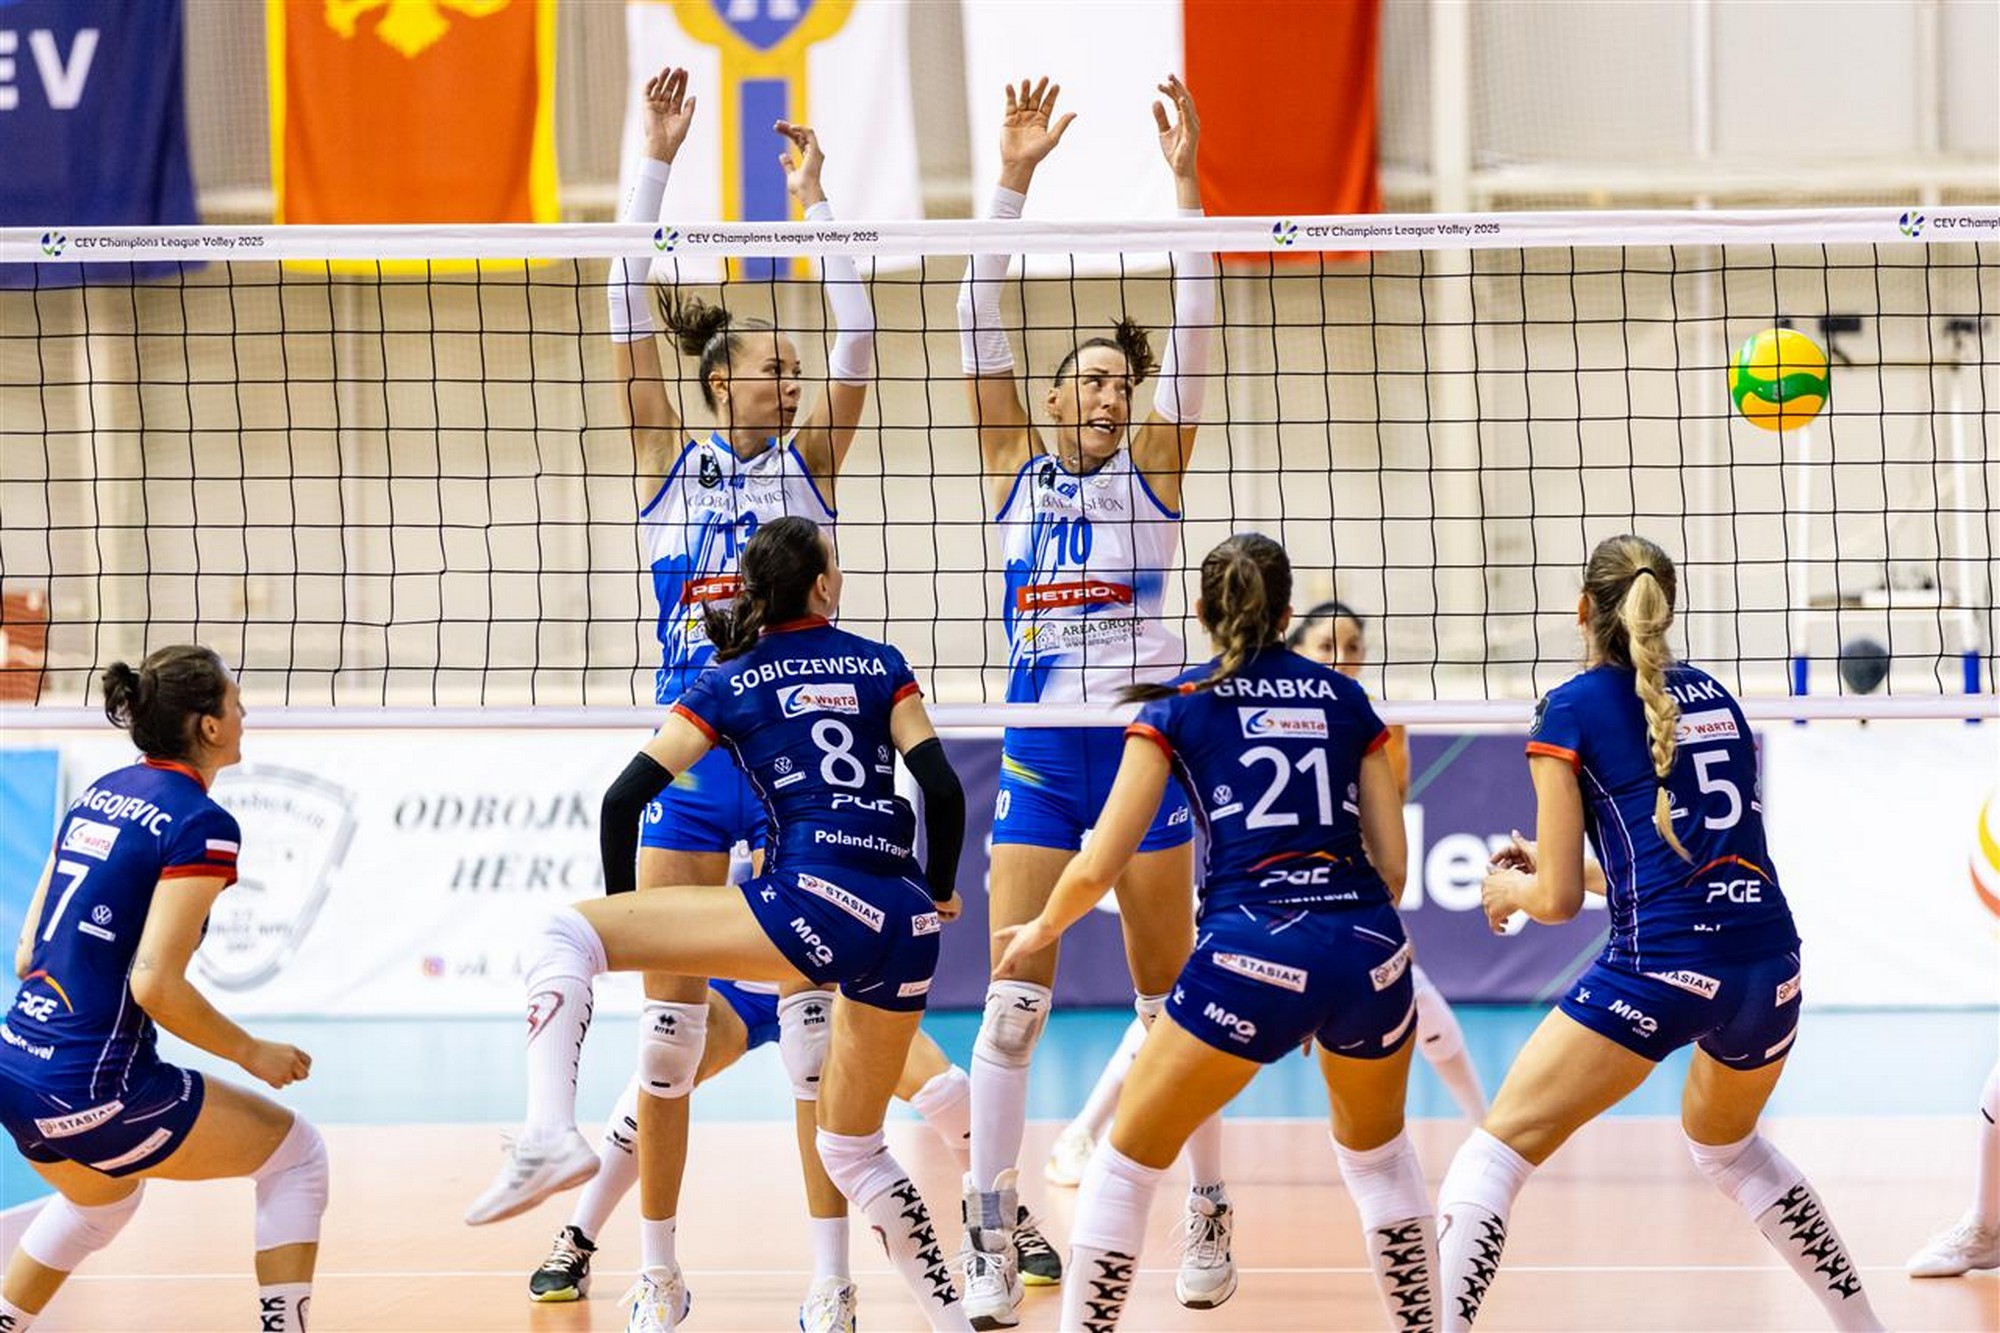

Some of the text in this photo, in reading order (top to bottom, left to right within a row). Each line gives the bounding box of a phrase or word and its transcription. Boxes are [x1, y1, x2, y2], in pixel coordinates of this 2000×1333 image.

[1306, 223, 1501, 239] CEV Champions League Volley 2025
[1933, 218, 1957, 228] CEV
[74, 235, 265, 250] CEV Champions League Volley 2025
[687, 231, 879, 245] CEV Champions League Volley 2025
[1051, 516, 1093, 566] 10
[1062, 622, 1096, 637] AREA
[1098, 617, 1144, 631] GROUP
[729, 656, 887, 697] SOBICZEWSKA
[1213, 678, 1338, 700] GRABKA
[1662, 679, 1724, 704] SIAK
[811, 718, 866, 789] 8
[1238, 746, 1333, 830] 21
[1692, 749, 1742, 830] 5
[72, 787, 173, 836] AGOJEVIC
[994, 789, 1011, 820] 10
[42, 860, 90, 941] 7
[1706, 879, 1762, 903] PGE
[825, 886, 880, 924] STASIAK
[1239, 958, 1301, 985] STASIAK
[1662, 971, 1714, 992] TASIAK
